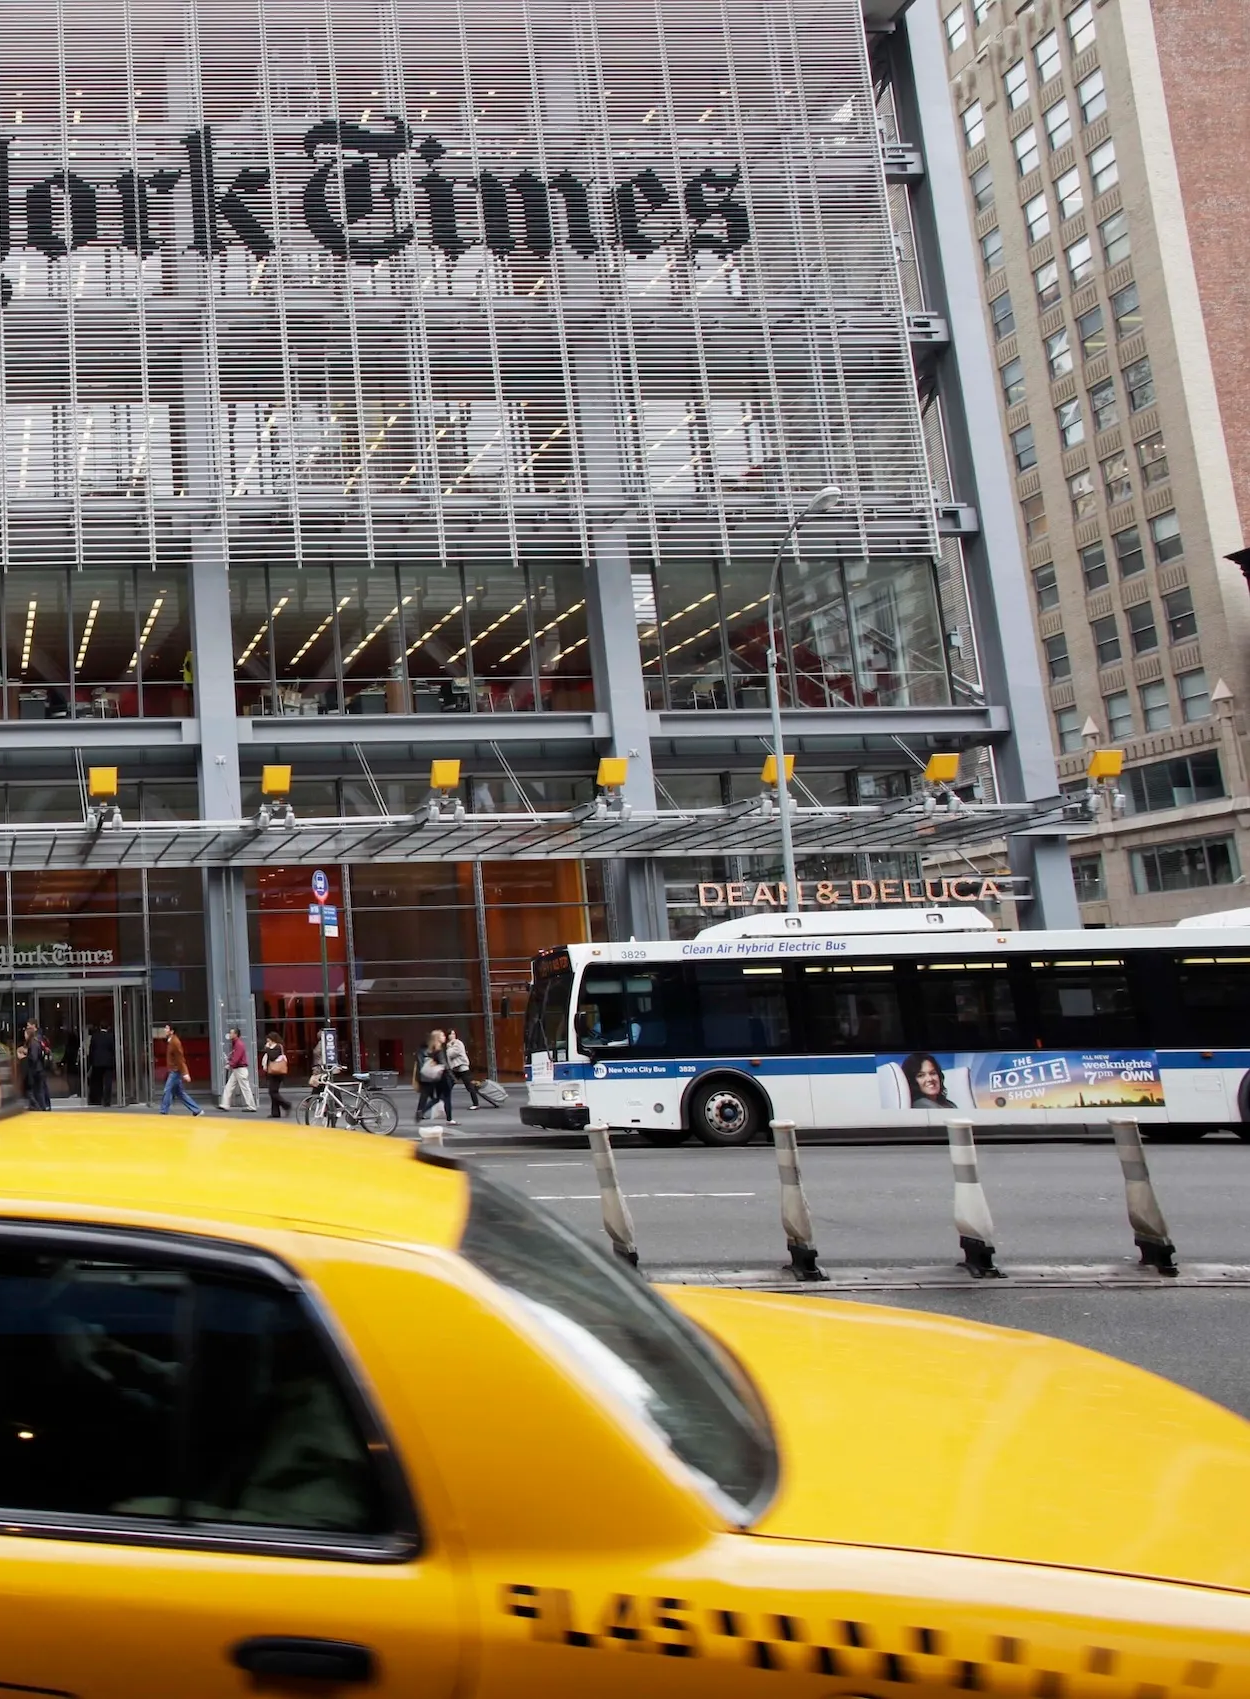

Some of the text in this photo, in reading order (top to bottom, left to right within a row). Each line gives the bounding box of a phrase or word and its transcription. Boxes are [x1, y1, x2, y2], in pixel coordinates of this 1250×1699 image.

[301, 115, 750, 267] Times
[816, 880, 840, 905] &
[852, 877, 1002, 904] DELUCA
[52, 943, 114, 966] Times
[682, 940, 847, 955] Clean Air Hybrid Electric Bus
[621, 951, 646, 959] 3829
[1012, 1056, 1032, 1066] THE
[1083, 1059, 1152, 1071] weeknights
[638, 1066, 652, 1074] City
[991, 1063, 1065, 1089] ROSIE
[1120, 1070, 1155, 1082] OWN
[1008, 1087, 1046, 1101] SHOW
